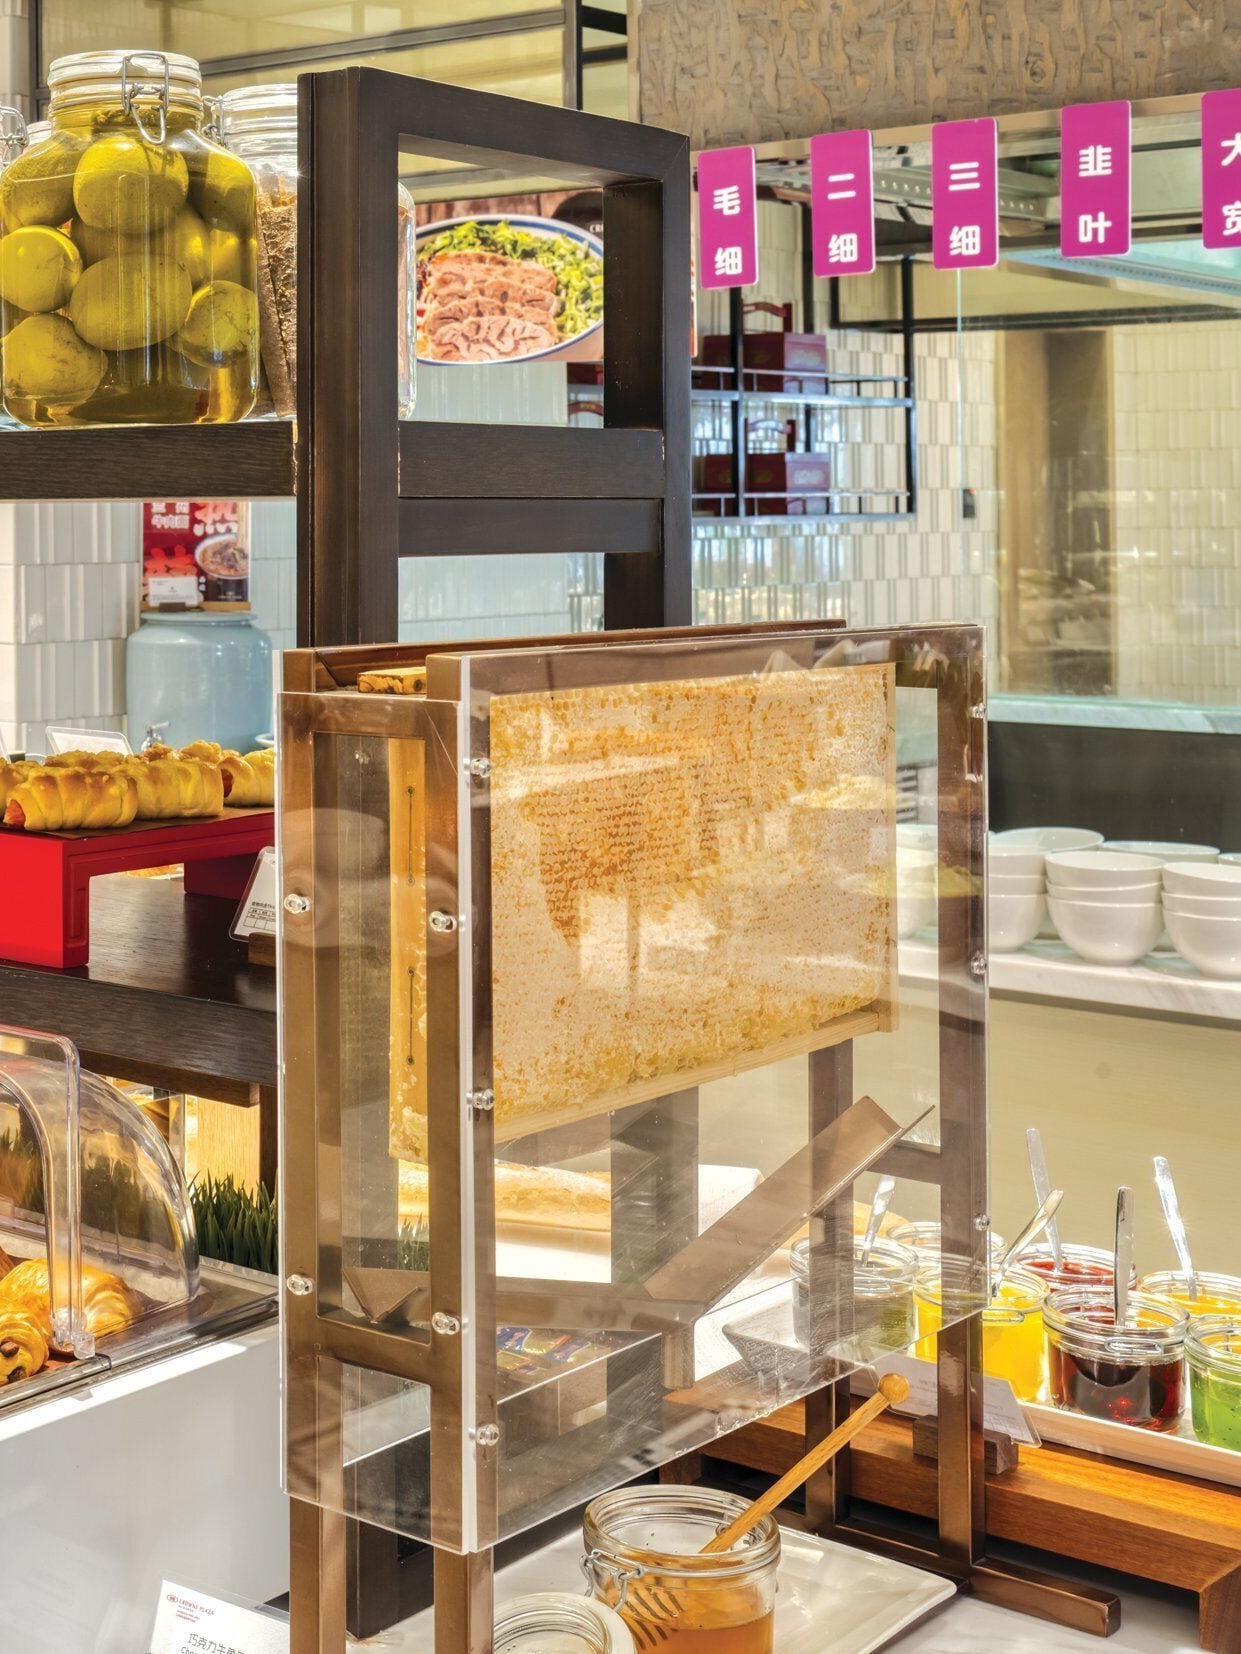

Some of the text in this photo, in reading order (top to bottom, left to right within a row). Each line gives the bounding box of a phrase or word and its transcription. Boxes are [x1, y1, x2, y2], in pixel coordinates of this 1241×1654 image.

[712, 184, 743, 276] 毛细
[827, 172, 859, 263] 二细
[948, 161, 981, 256] 三细
[1078, 144, 1112, 244] 韭叶
